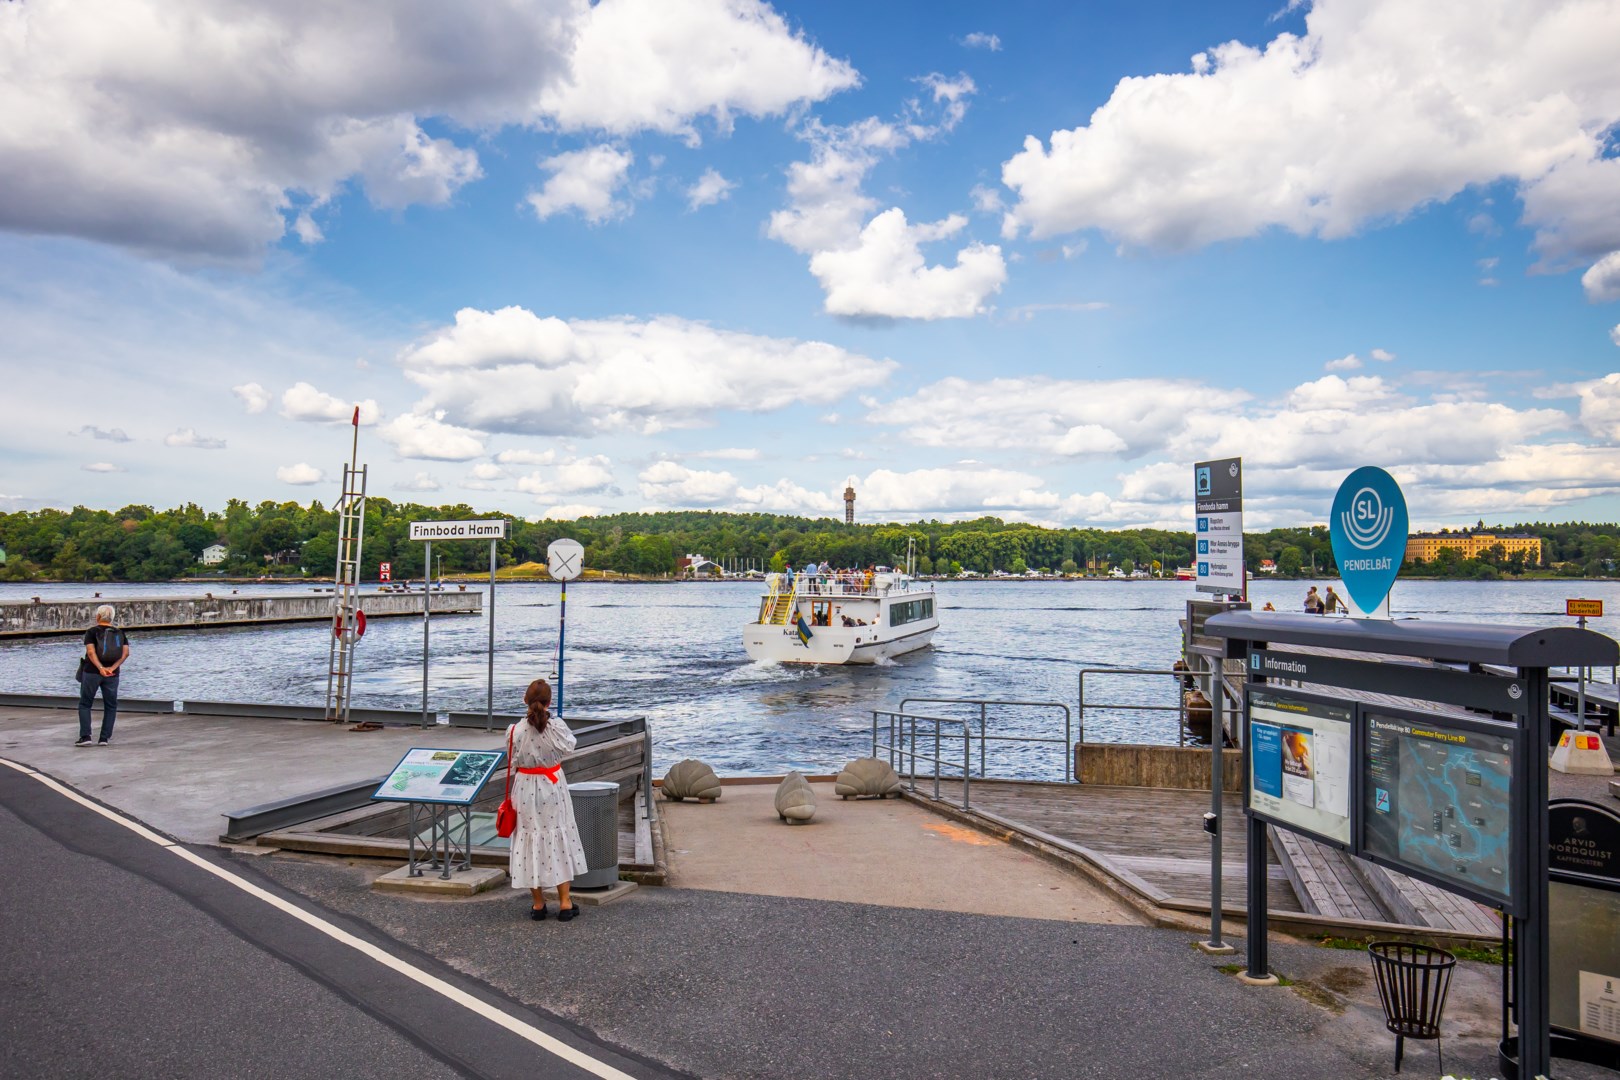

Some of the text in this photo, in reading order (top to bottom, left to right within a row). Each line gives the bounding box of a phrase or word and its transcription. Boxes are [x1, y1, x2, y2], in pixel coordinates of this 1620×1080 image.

[1197, 501, 1228, 511] Finnboda hamn
[1357, 499, 1376, 520] SL
[414, 523, 500, 536] Finnboda Hamn
[1200, 520, 1207, 530] 80
[1200, 542, 1207, 552] 80
[1200, 564, 1207, 574] 80
[1344, 556, 1392, 571] PENDELBÅT
[783, 628, 799, 636] Kata
[1264, 656, 1307, 674] Information
[1411, 727, 1434, 739] Commuter
[1434, 731, 1447, 741] Ferry
[1447, 734, 1458, 743] Line
[1564, 838, 1596, 848] ARVID
[1548, 843, 1612, 859] NORDQUIST
